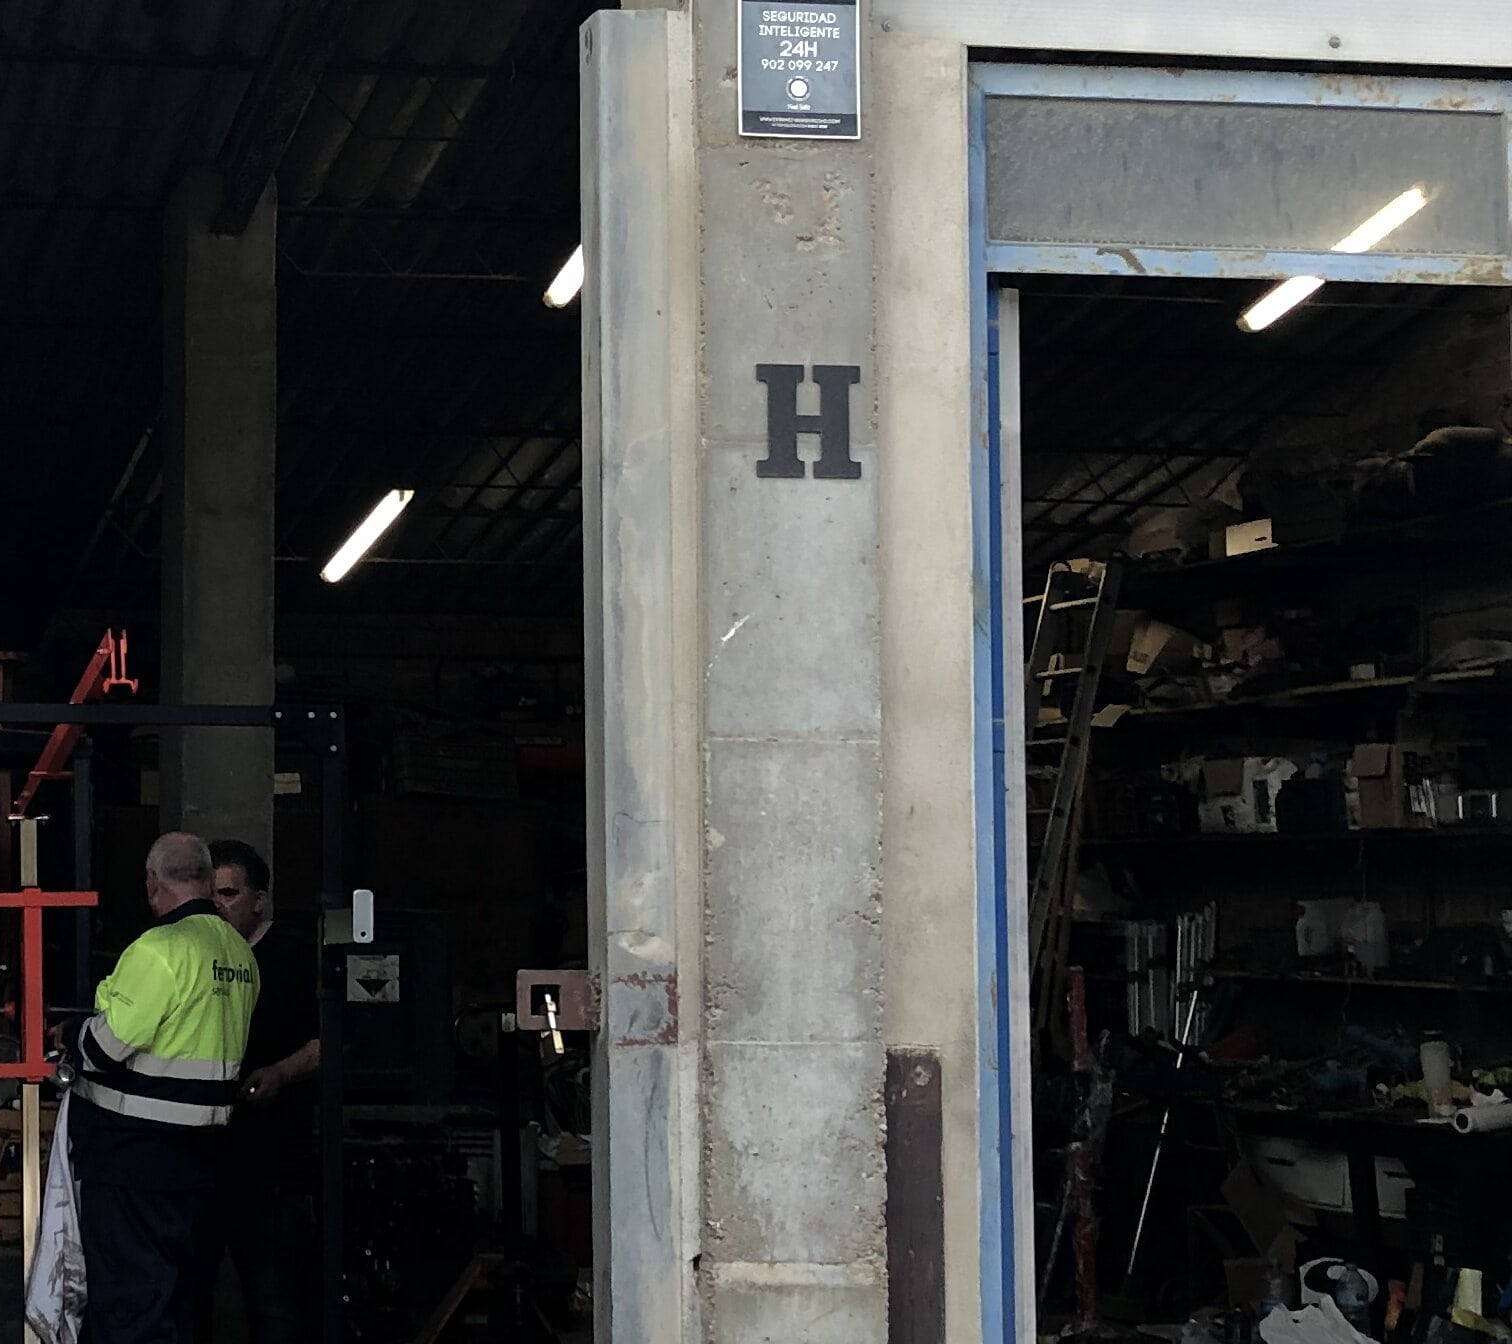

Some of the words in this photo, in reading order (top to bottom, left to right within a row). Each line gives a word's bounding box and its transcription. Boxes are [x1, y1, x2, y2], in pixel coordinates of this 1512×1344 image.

[762, 10, 837, 24] SEGURIDAD
[758, 24, 841, 39] INTELIGENTE
[779, 40, 818, 58] 24H
[761, 58, 785, 71] 902
[788, 59, 813, 71] 099
[815, 60, 839, 72] 247
[756, 363, 861, 479] H
